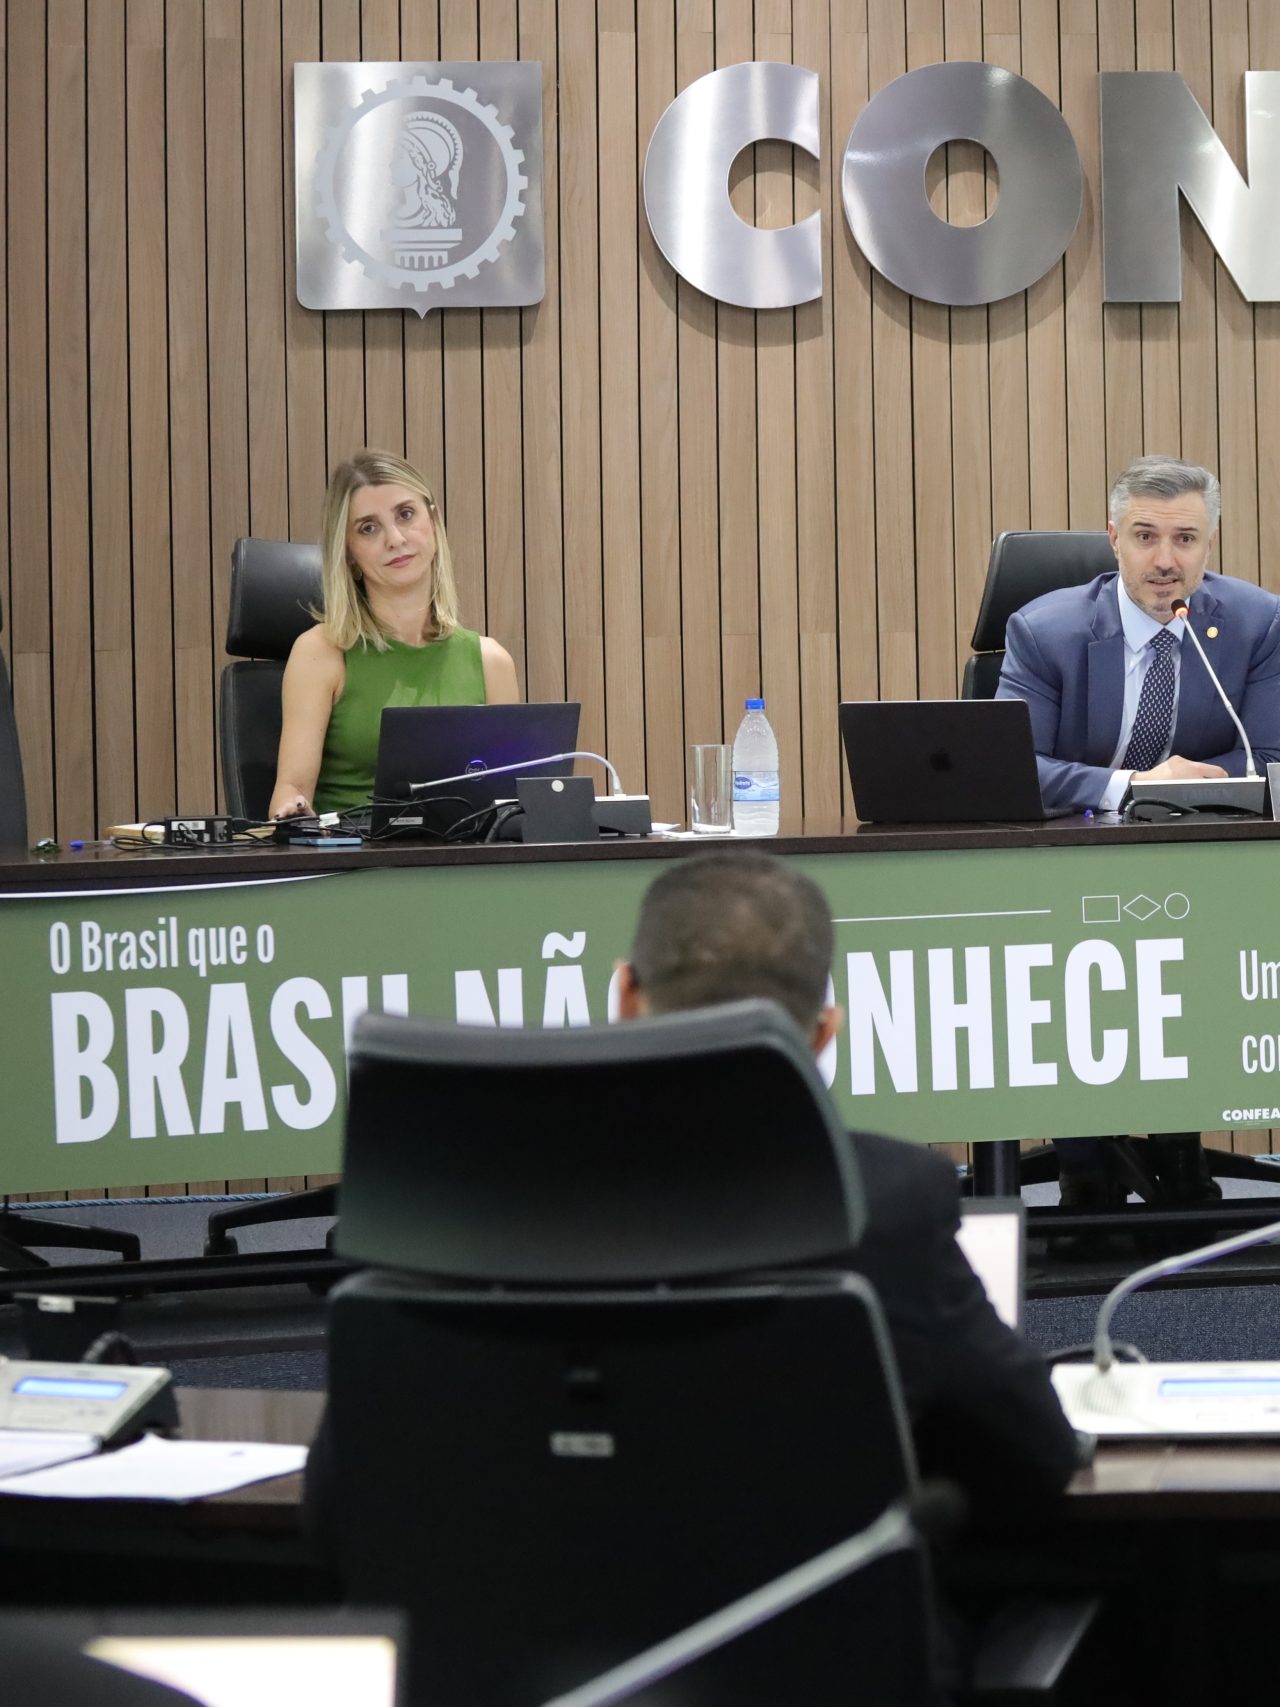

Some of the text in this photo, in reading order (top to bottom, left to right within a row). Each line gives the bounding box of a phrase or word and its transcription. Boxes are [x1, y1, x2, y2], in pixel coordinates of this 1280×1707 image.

[50, 916, 275, 977] O Brasil que o
[50, 973, 409, 1144] BRAS
[827, 938, 1189, 1096] NHECE
